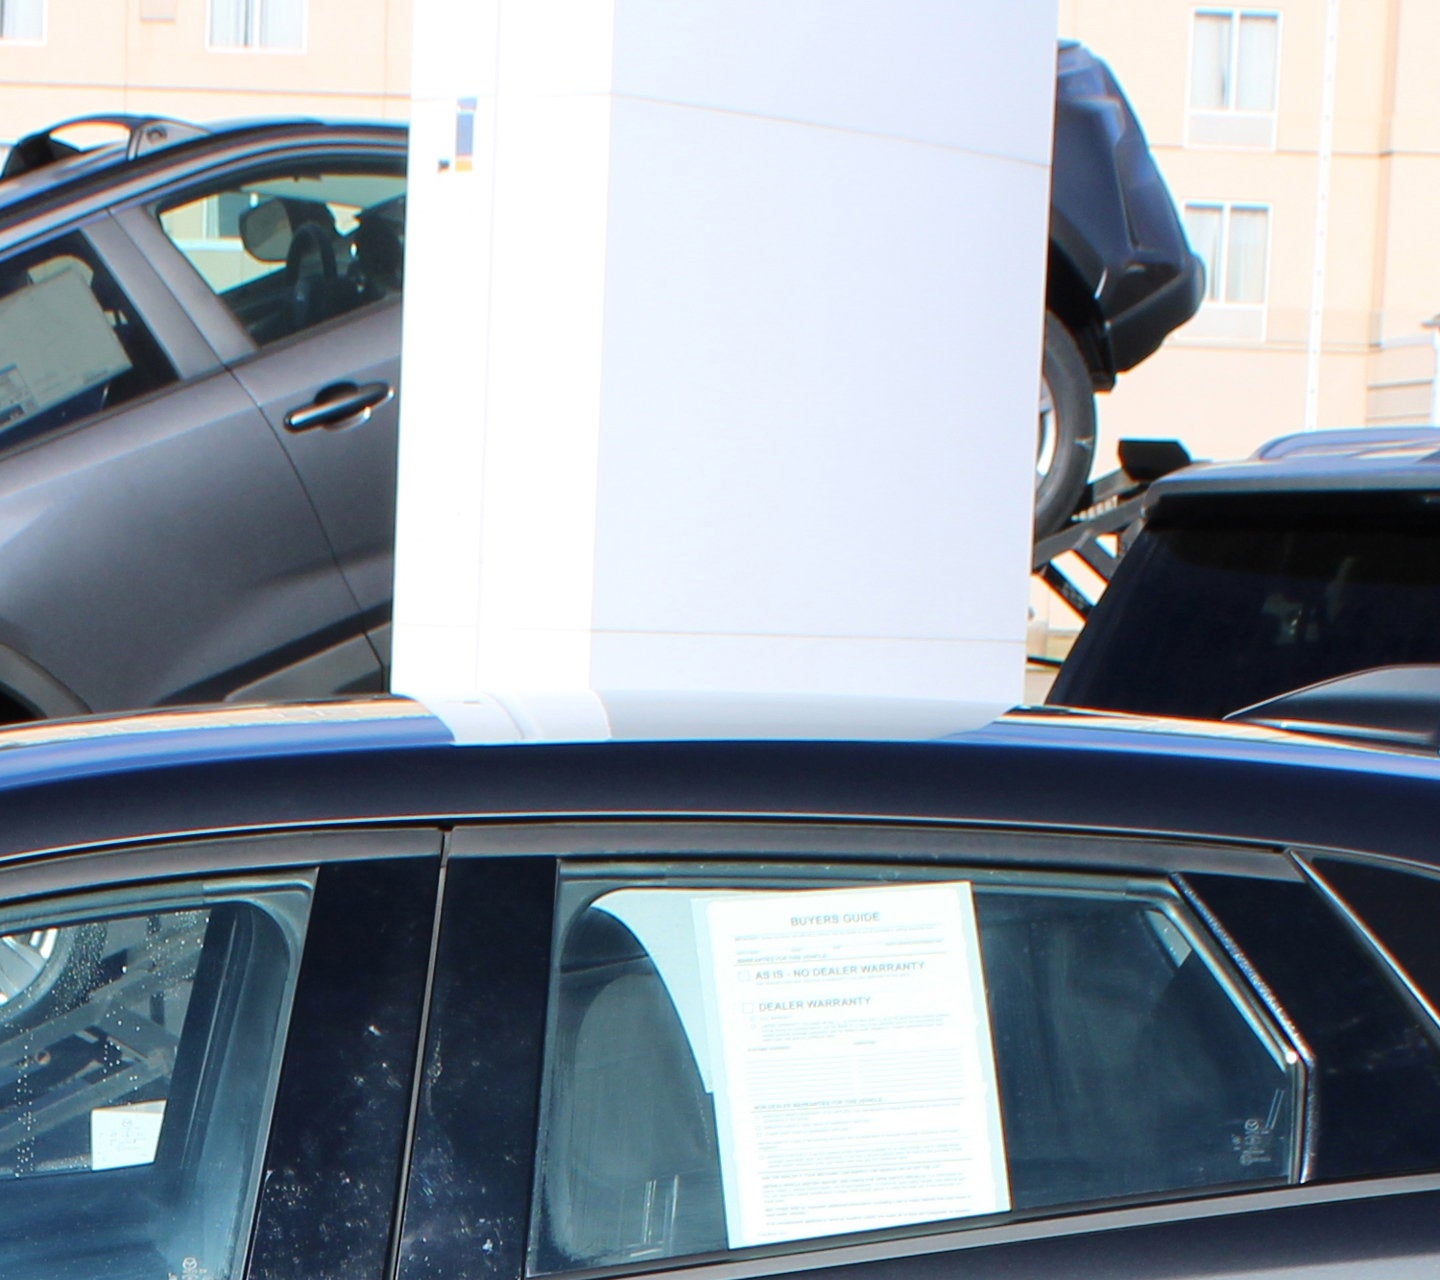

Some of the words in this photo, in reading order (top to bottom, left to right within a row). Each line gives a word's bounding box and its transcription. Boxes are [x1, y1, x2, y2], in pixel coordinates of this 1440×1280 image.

[791, 914, 839, 926] BUYERS
[843, 912, 880, 923] GUIDE
[755, 969, 770, 980] AS
[773, 969, 784, 979] IS
[793, 967, 810, 978] NO
[813, 964, 857, 977] DEALER
[860, 961, 925, 974] WARRANTY
[759, 999, 804, 1012] DEALER
[806, 996, 872, 1009] WARRANTY
